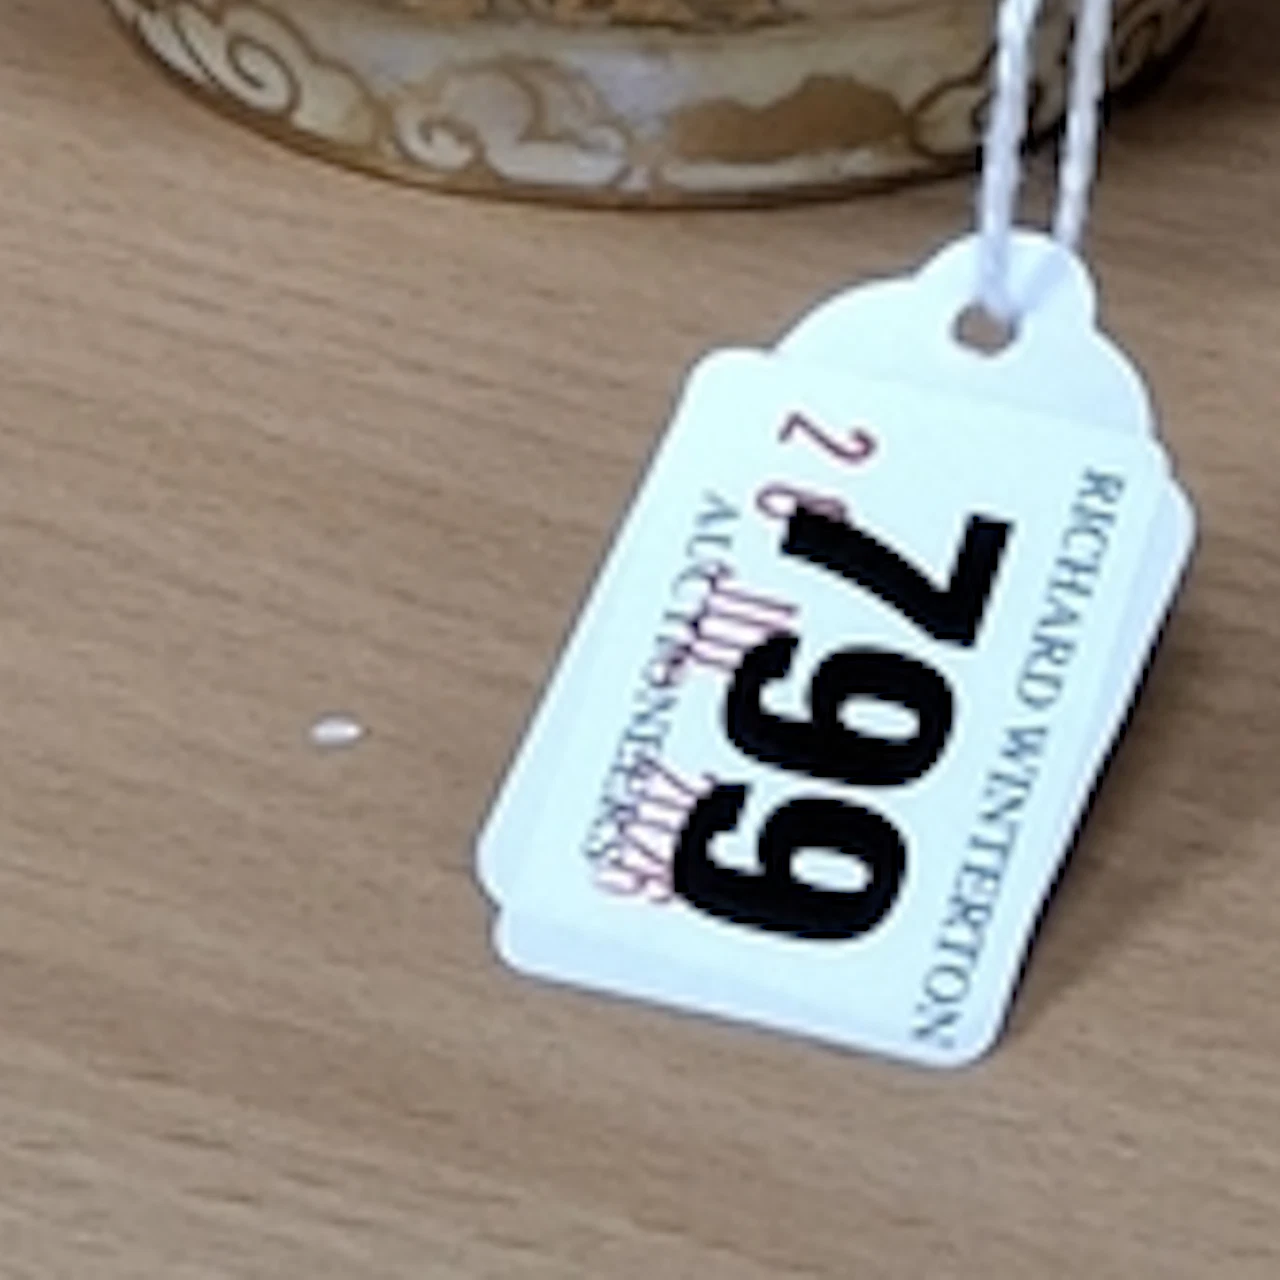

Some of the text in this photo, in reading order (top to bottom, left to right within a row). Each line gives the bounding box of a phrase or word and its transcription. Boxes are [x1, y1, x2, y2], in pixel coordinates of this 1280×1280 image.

[582, 490, 740, 860] AUCTIONEERS
[673, 512, 1015, 942] 799
[914, 466, 1125, 1048] RICHARD WINTERTON
